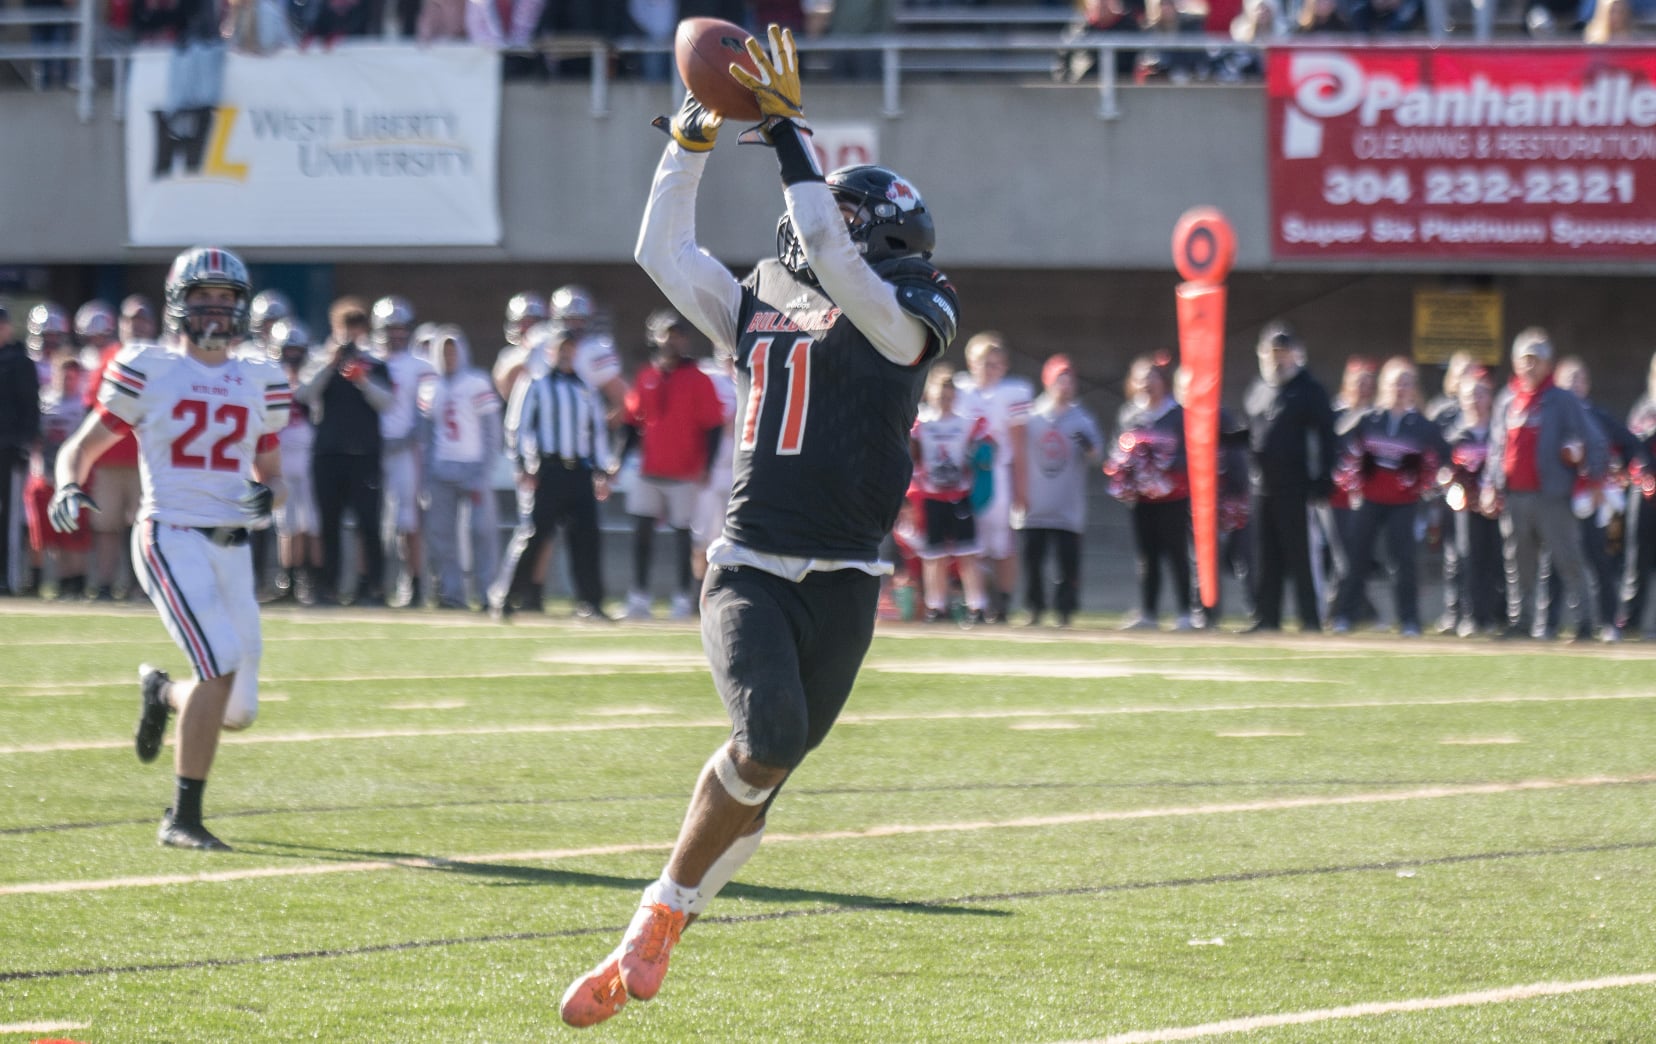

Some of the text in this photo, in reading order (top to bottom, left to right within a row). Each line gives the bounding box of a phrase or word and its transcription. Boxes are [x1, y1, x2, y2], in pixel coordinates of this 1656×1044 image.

[1359, 74, 1656, 127] Panhandle
[248, 107, 459, 141] WEST LIBERTY
[298, 144, 473, 178] UNIVERSITY
[1323, 167, 1635, 205] 304 232-2321
[1281, 213, 1366, 247] Super
[1371, 214, 1416, 243] Six
[1420, 215, 1547, 243] Platinum
[746, 307, 842, 333] BULLDOGS
[740, 337, 814, 455] 11
[171, 399, 248, 473] 22
